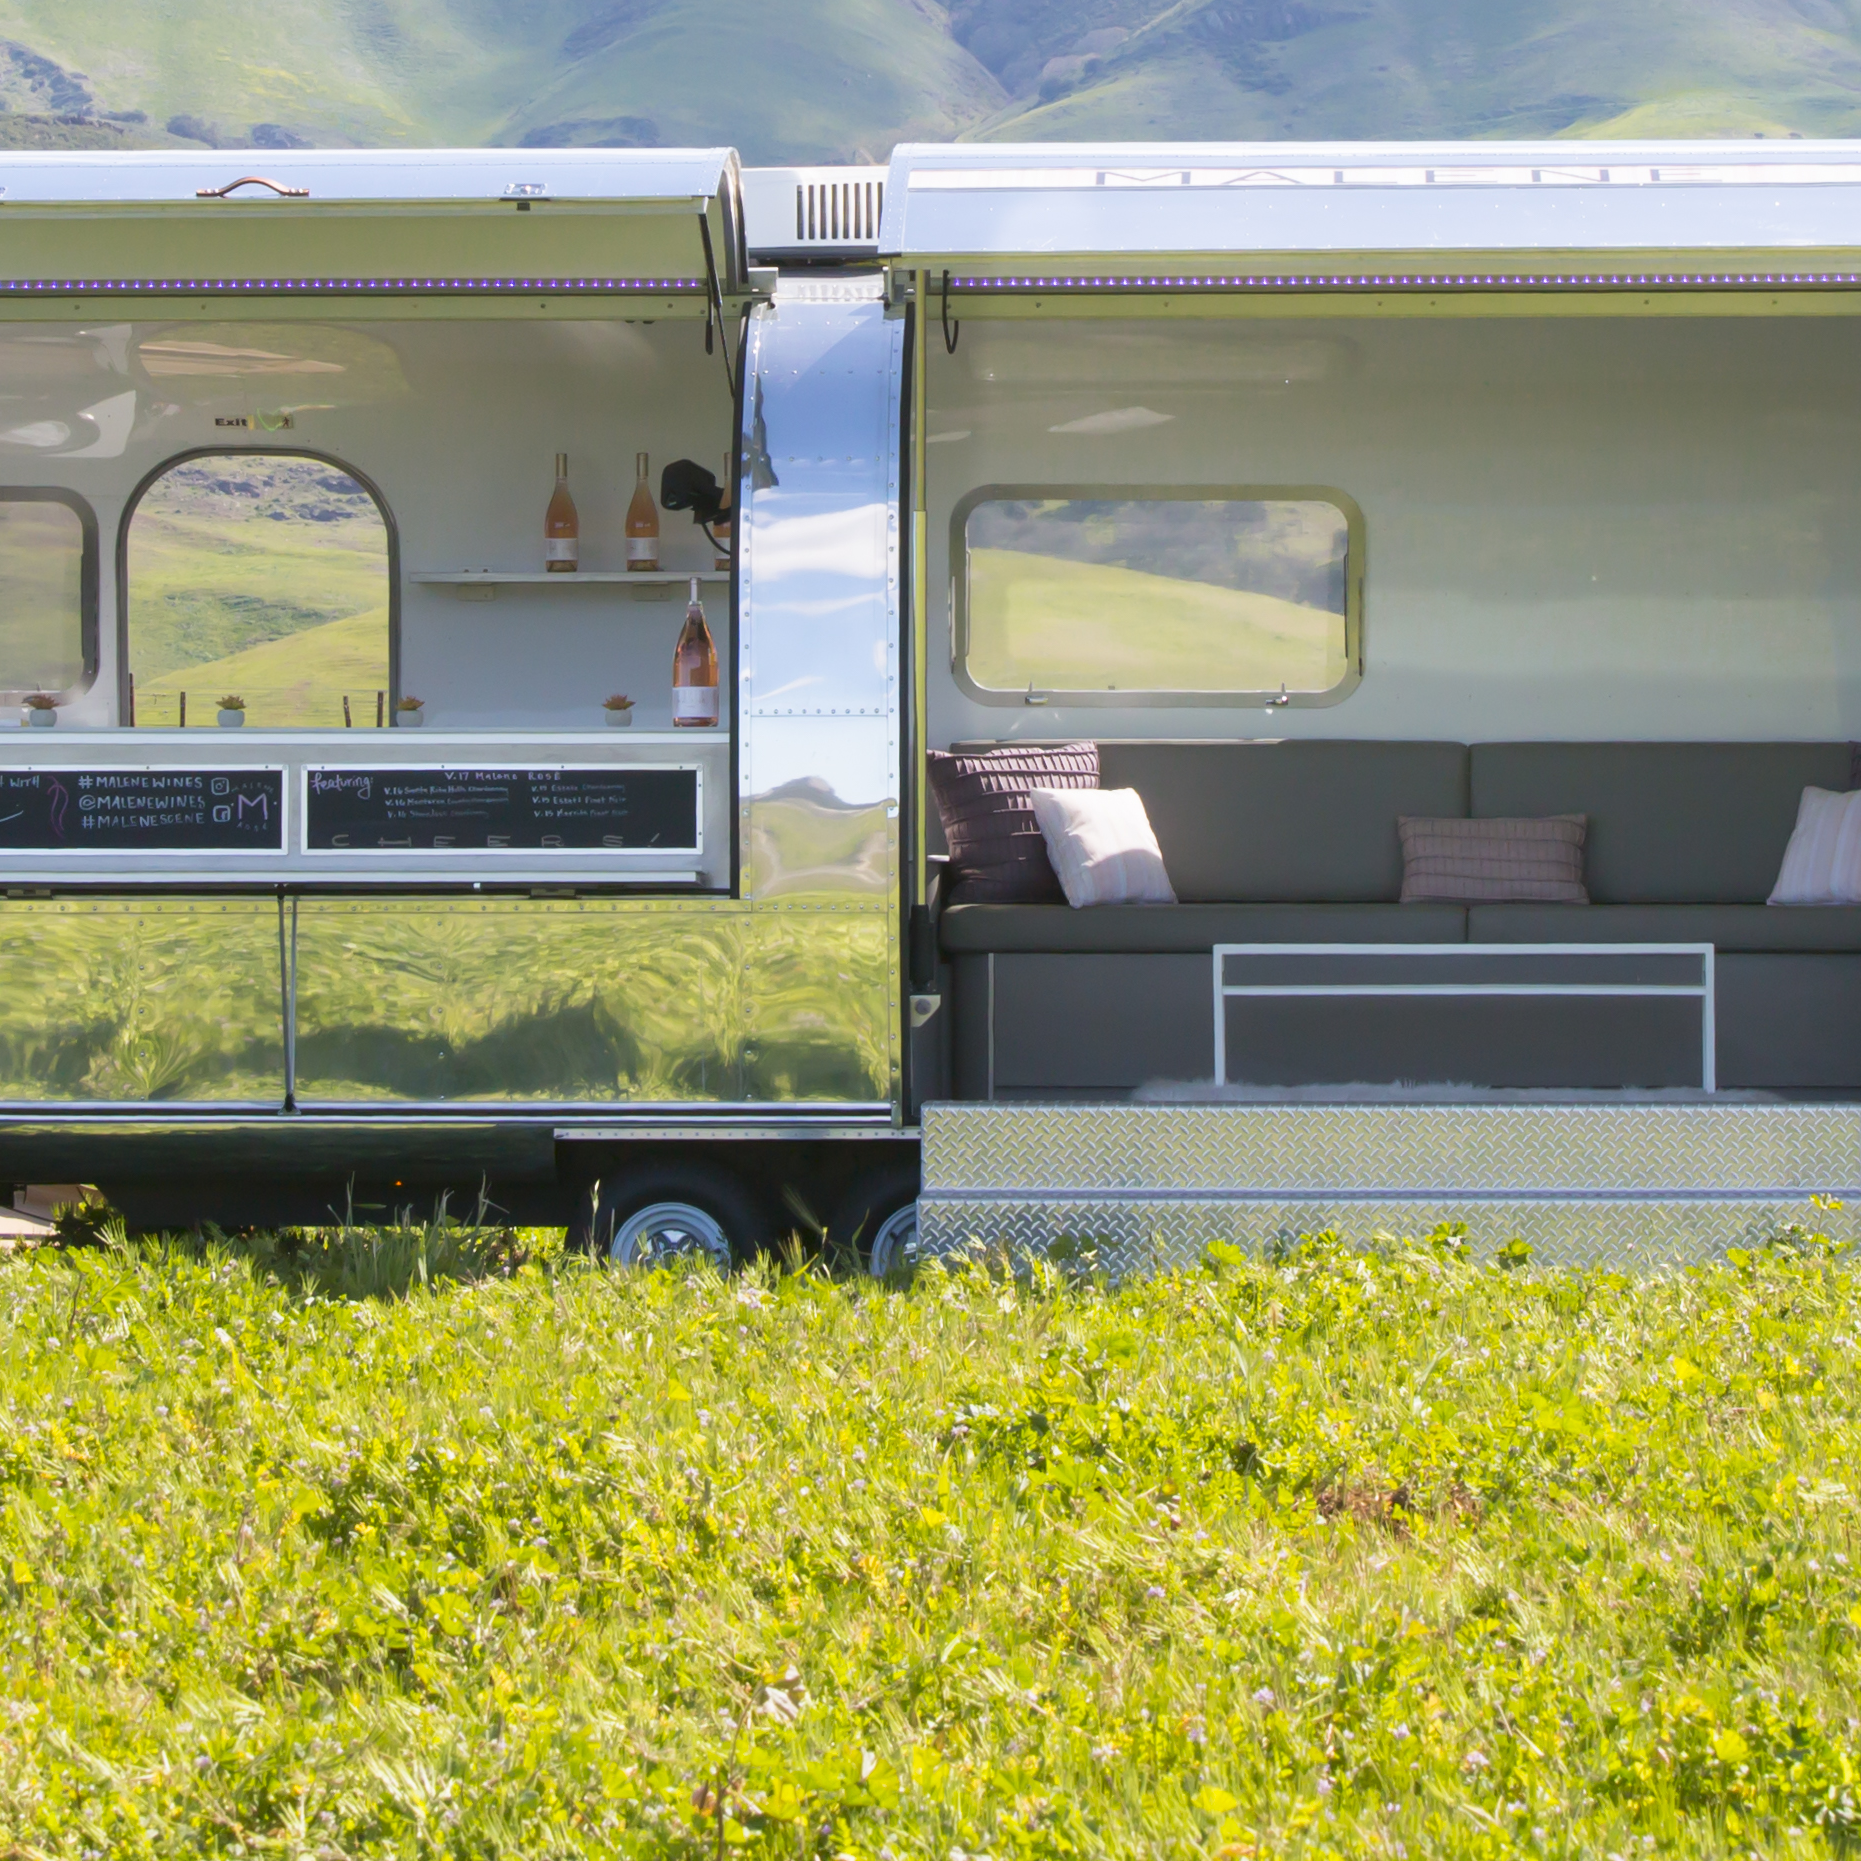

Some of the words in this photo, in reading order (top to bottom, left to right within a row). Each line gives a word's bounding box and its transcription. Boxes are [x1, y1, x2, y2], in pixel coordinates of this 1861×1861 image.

[1095, 168, 1723, 185] MALENE
[214, 418, 248, 427] Exit
[9, 775, 40, 789] WITH
[444, 771, 470, 781] V.17
[310, 771, 374, 800] featuring:
[79, 794, 206, 810] @MALENEWINES
[81, 812, 206, 829] #MALENESCENE
